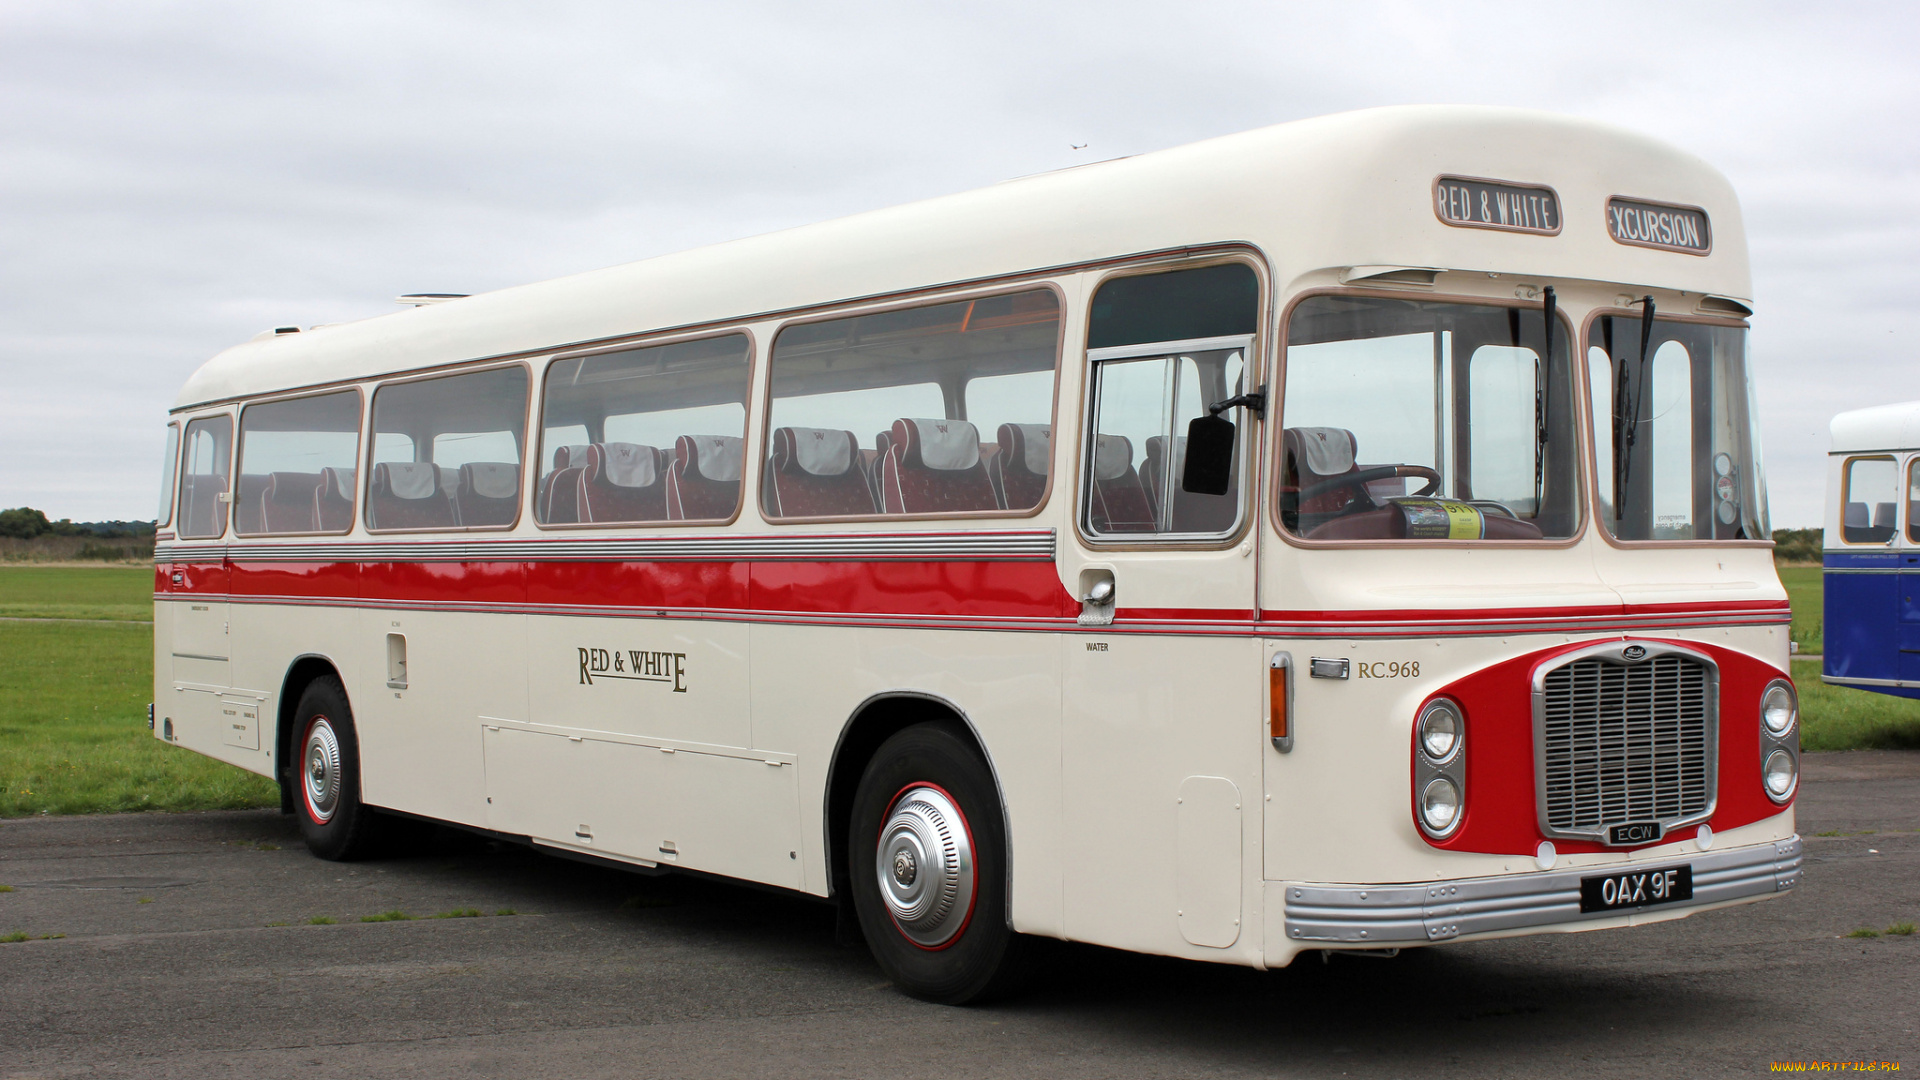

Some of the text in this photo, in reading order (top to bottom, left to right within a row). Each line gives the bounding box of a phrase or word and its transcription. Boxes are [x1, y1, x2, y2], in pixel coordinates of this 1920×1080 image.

[1438, 185, 1553, 230] RED & WHITE
[1085, 642, 1109, 651] WATER
[577, 647, 688, 693] RED & WHITE
[1358, 661, 1420, 679] RC.968
[1617, 826, 1653, 841] ECW
[1602, 869, 1678, 905] OAX 9F
